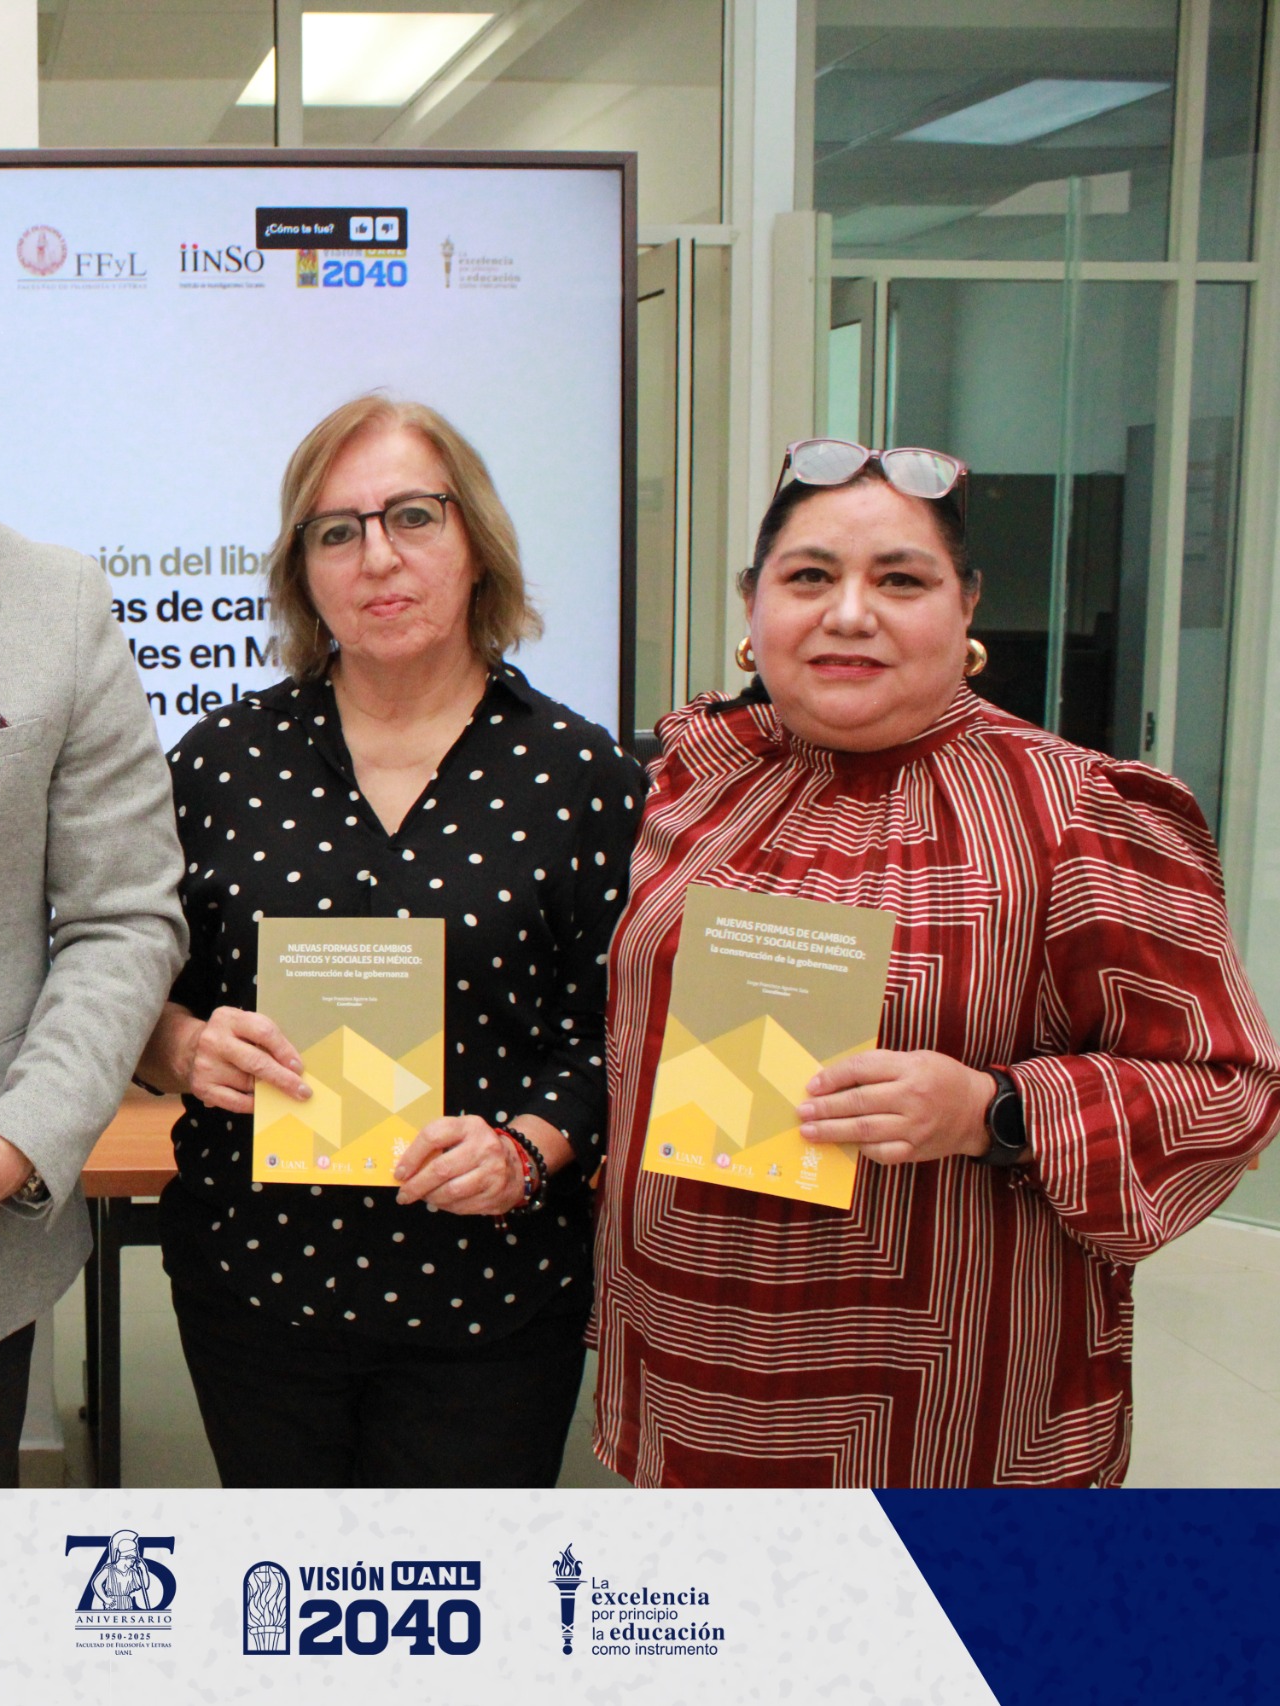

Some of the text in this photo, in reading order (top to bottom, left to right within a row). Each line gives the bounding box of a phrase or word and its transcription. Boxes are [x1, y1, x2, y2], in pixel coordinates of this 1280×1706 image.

[264, 224, 335, 237] ¿Cómo te fue?
[75, 253, 147, 277] FFyL
[323, 260, 408, 288] 2040
[92, 546, 151, 577] ión
[160, 546, 212, 576] del
[156, 590, 203, 622] de
[190, 644, 235, 669] en
[176, 684, 222, 715] de
[705, 927, 866, 960] POLÍTICOS Y SOCIALES EN MÉXICO:
[716, 916, 856, 945] NUEVAS FORMAS DE CAMBIOS
[279, 954, 422, 965] POLÍTICOS Y SOCIALES EN MÉXICO:
[288, 944, 412, 953] NUEVAS FORMAS DE CAMBIOS
[711, 944, 848, 973] la construcción de la gobernanza
[286, 969, 409, 979] la construcción de la gobernanza
